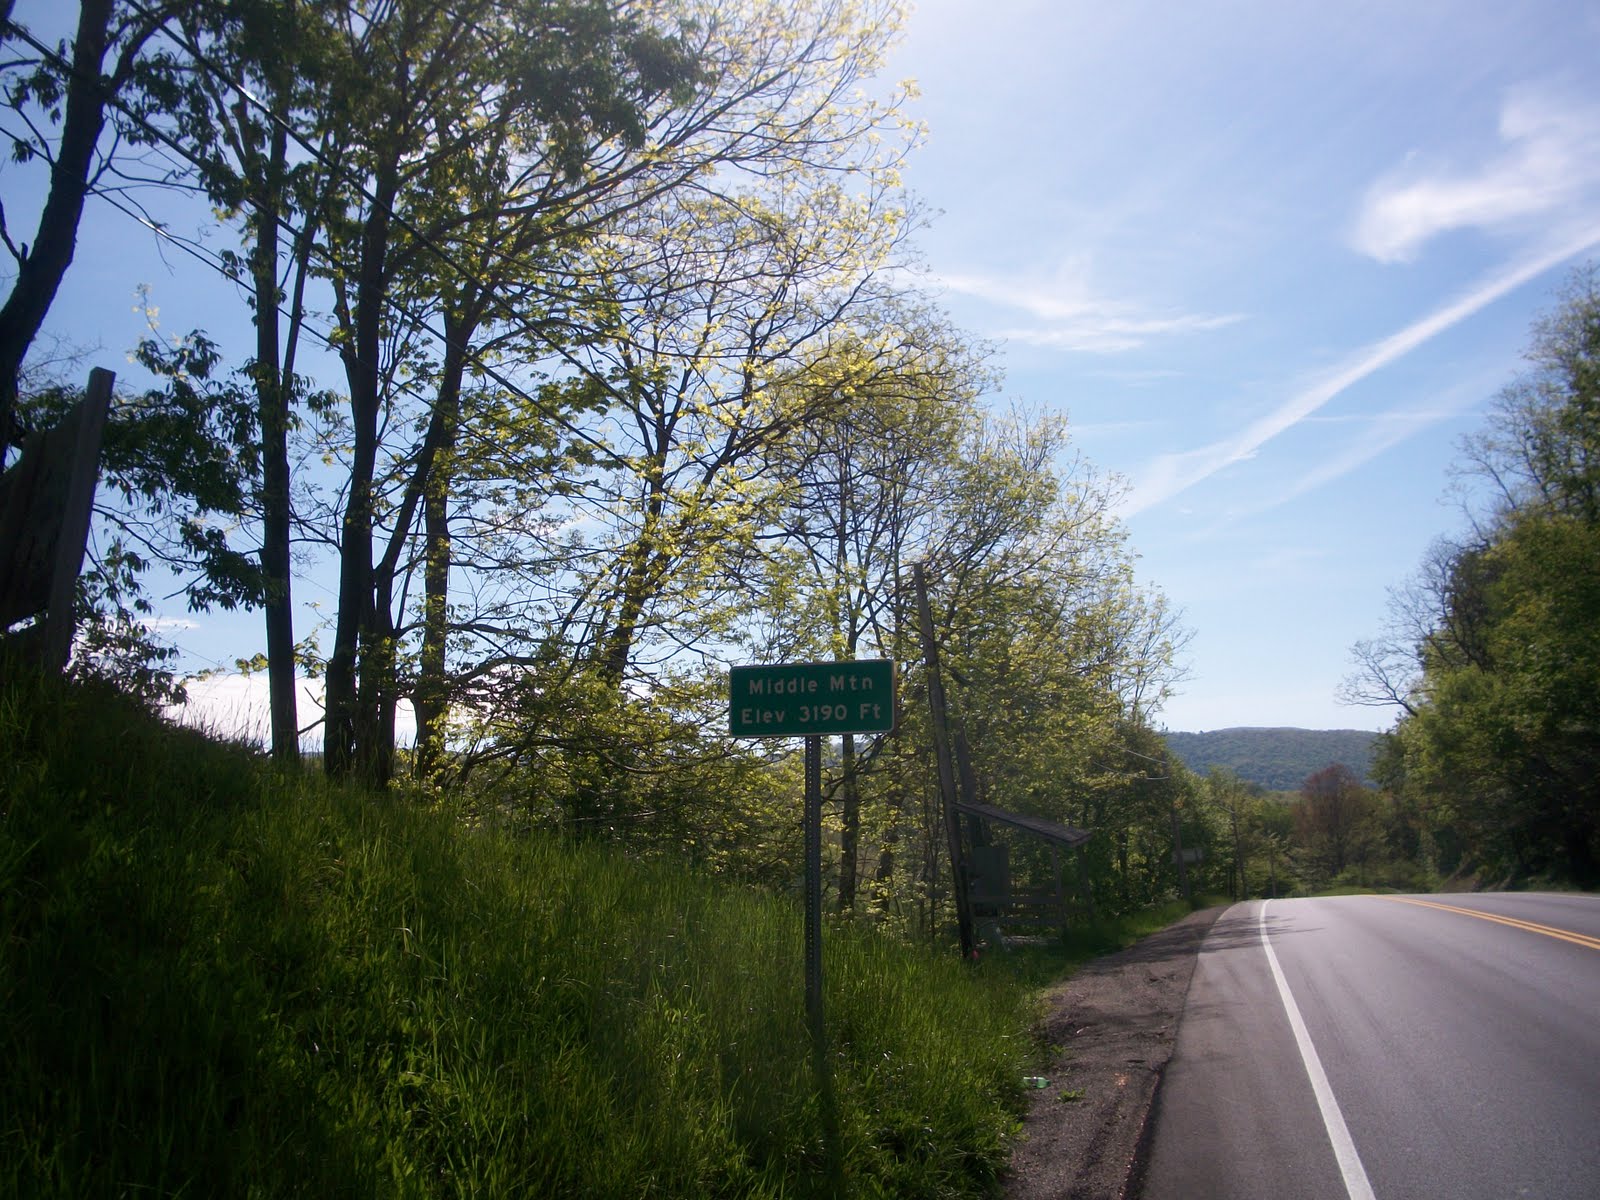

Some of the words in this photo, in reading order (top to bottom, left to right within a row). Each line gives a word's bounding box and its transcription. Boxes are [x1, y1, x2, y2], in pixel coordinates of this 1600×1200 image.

[749, 677, 818, 695] Middle
[830, 675, 873, 691] Mtn
[741, 707, 785, 724] Elev
[799, 704, 848, 722] 3190
[859, 703, 881, 720] Ft
